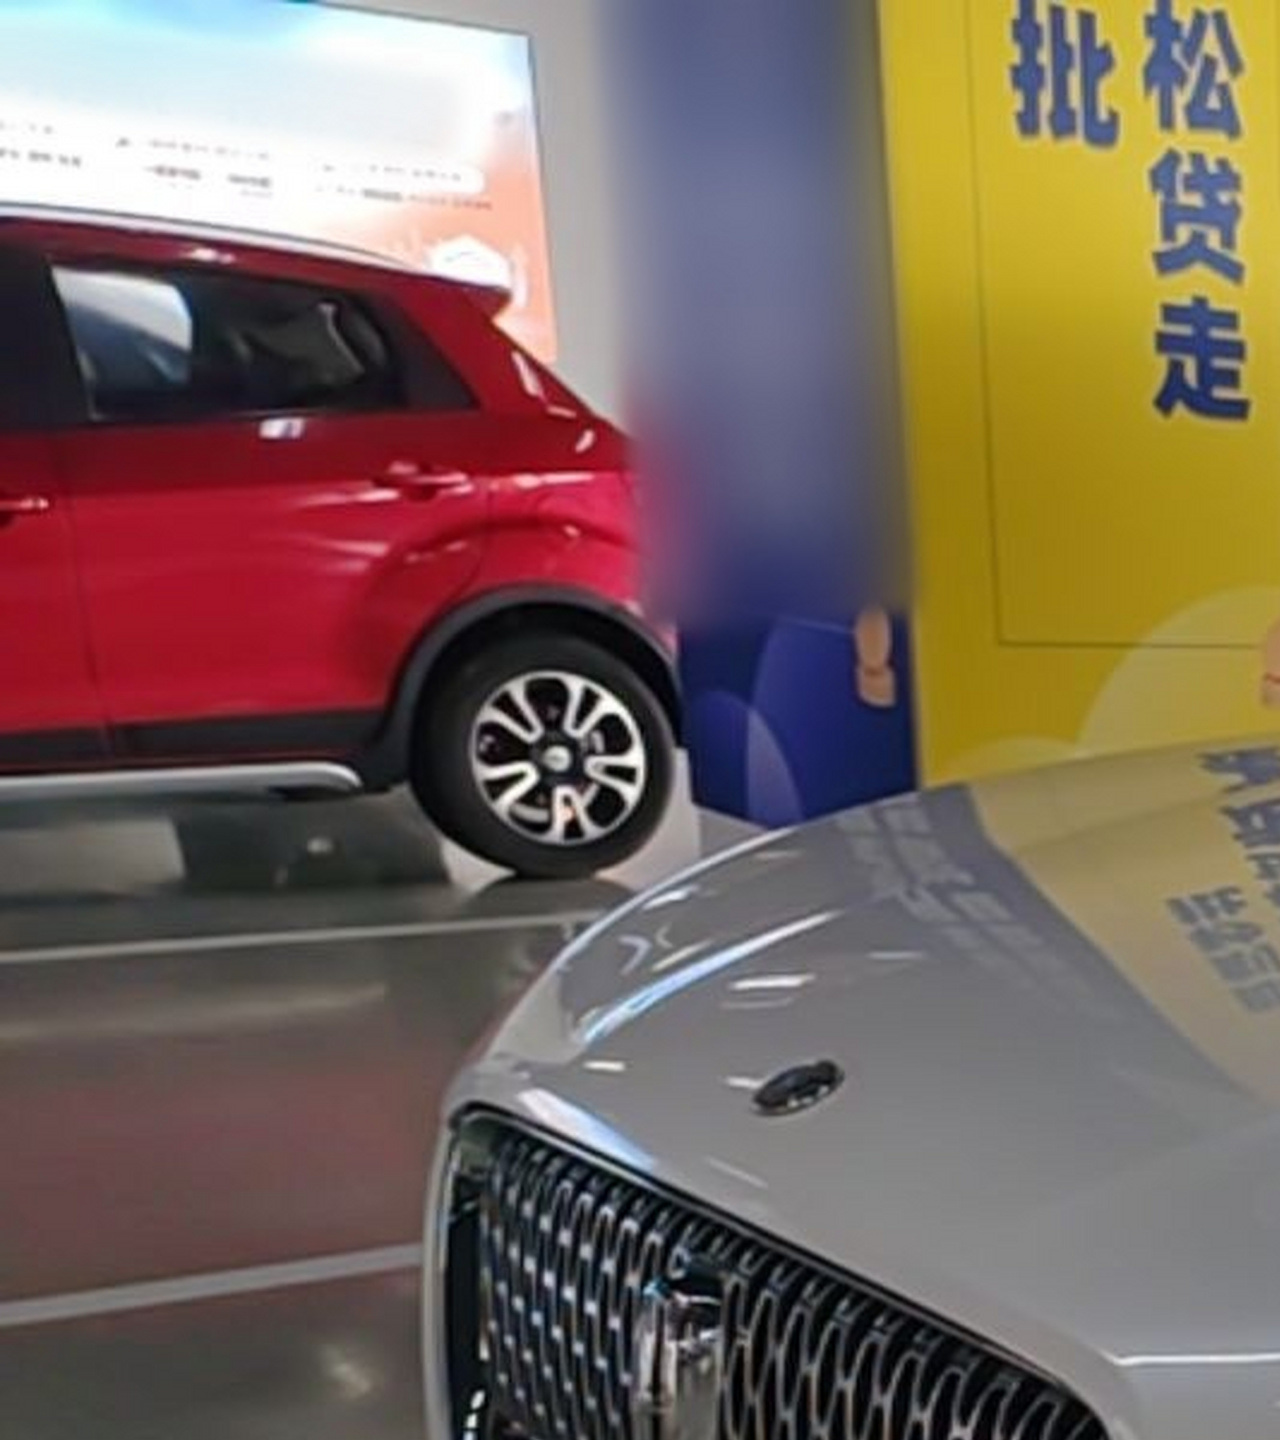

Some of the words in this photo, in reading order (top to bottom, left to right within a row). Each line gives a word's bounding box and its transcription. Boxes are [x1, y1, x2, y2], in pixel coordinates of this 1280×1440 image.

[1010, 0, 1120, 148] 批
[1142, 0, 1251, 422] 松贷走
